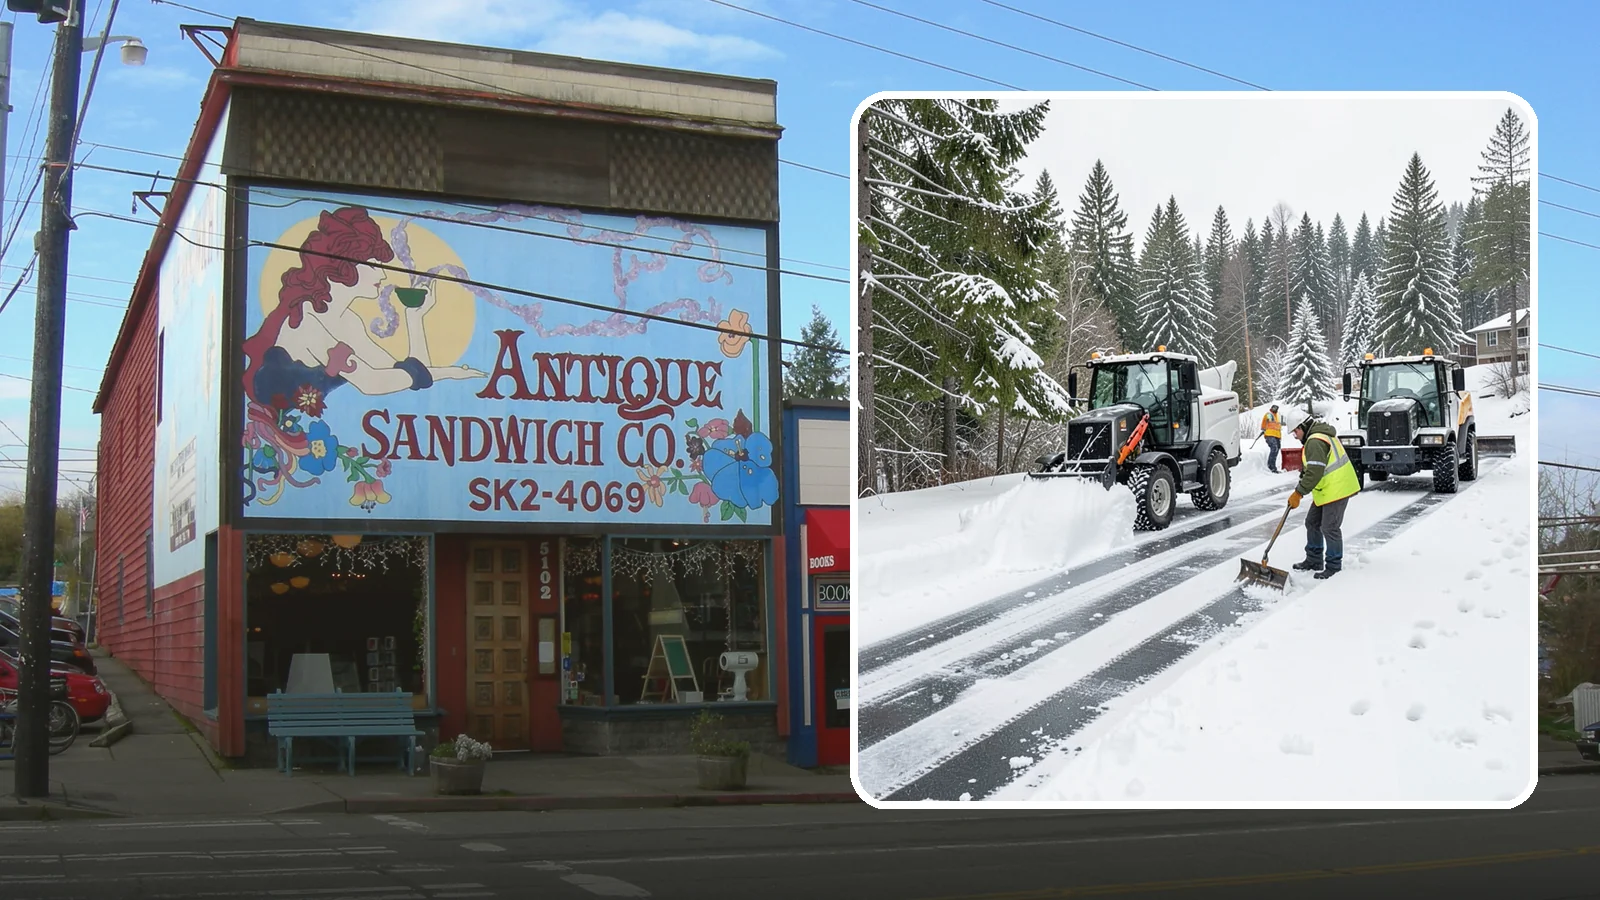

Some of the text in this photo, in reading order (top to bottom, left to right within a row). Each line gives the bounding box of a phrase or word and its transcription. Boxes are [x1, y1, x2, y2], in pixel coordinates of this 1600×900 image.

[476, 329, 724, 421] ANTIQUE
[361, 408, 685, 468] SANDWICH CO.
[468, 476, 646, 513] SK2-4069
[540, 541, 551, 600] 5102
[809, 555, 835, 569] BOOKS
